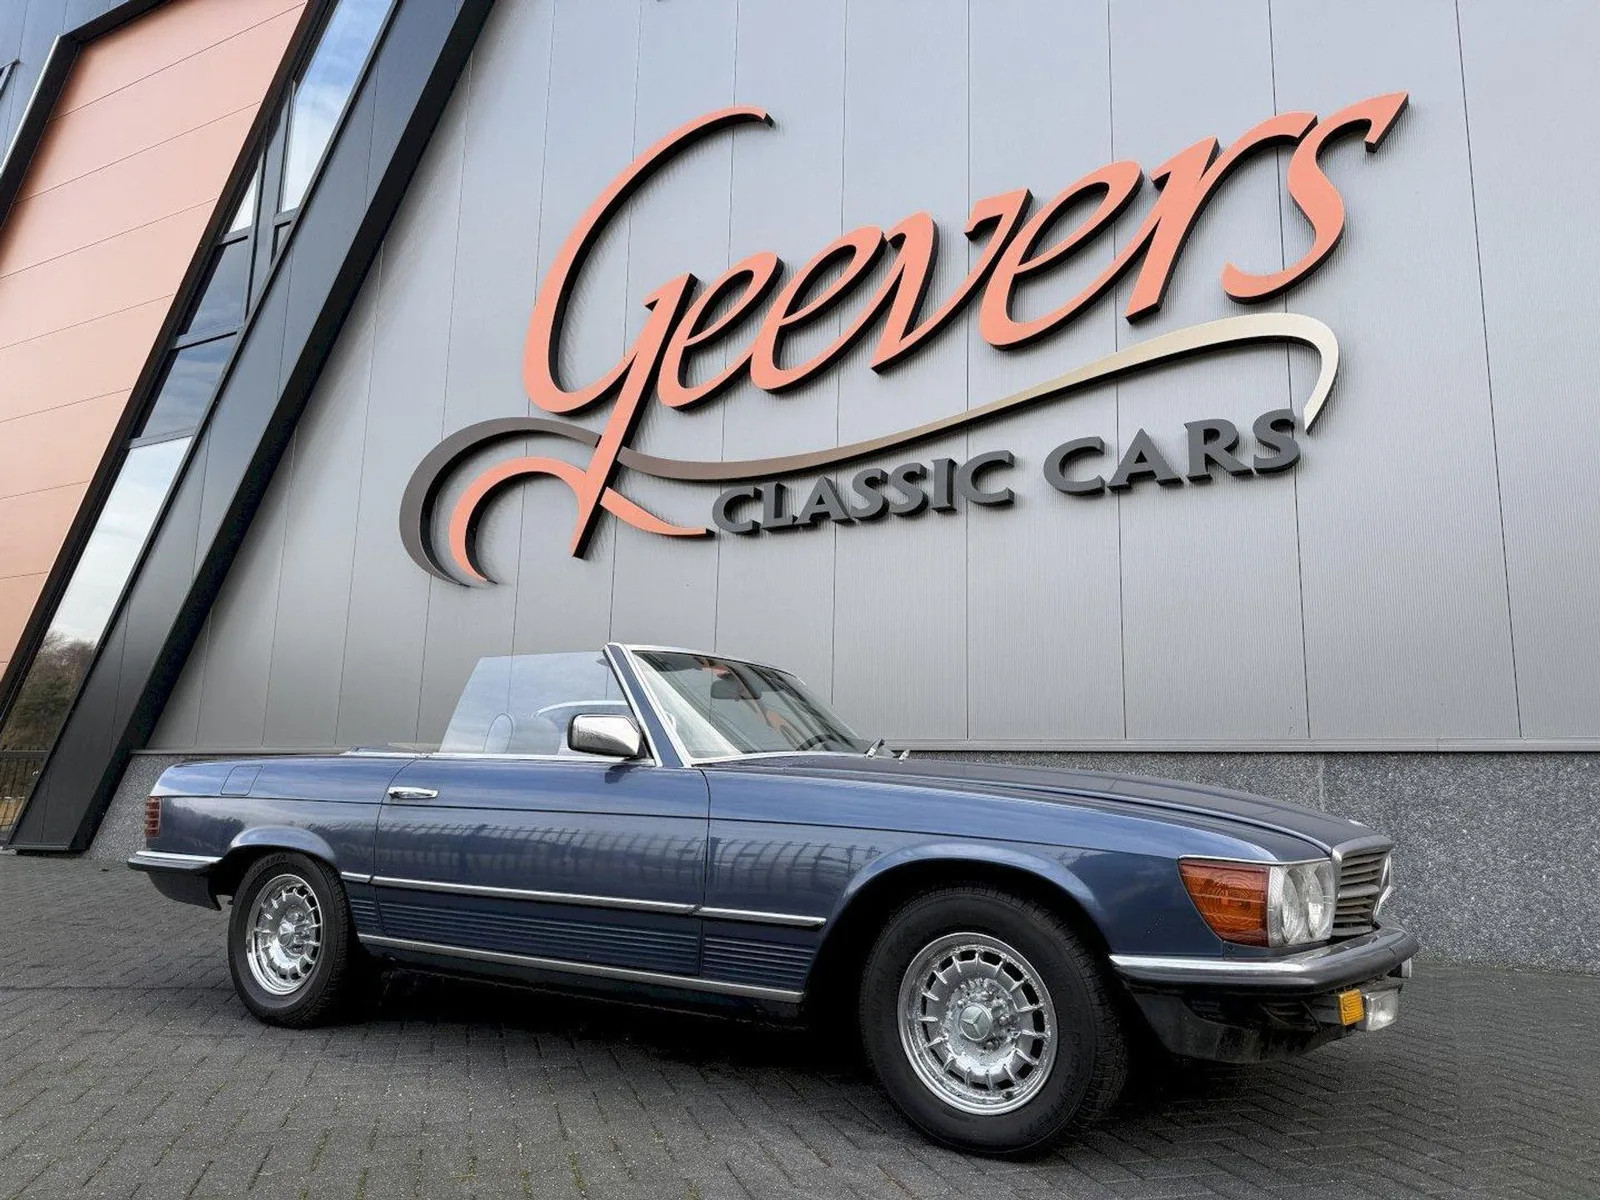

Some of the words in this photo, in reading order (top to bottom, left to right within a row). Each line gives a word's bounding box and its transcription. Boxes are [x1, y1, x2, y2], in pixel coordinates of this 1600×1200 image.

[523, 92, 1409, 559] Geevers
[711, 449, 1015, 536] CLASSIC
[1043, 407, 1301, 496] CARS
